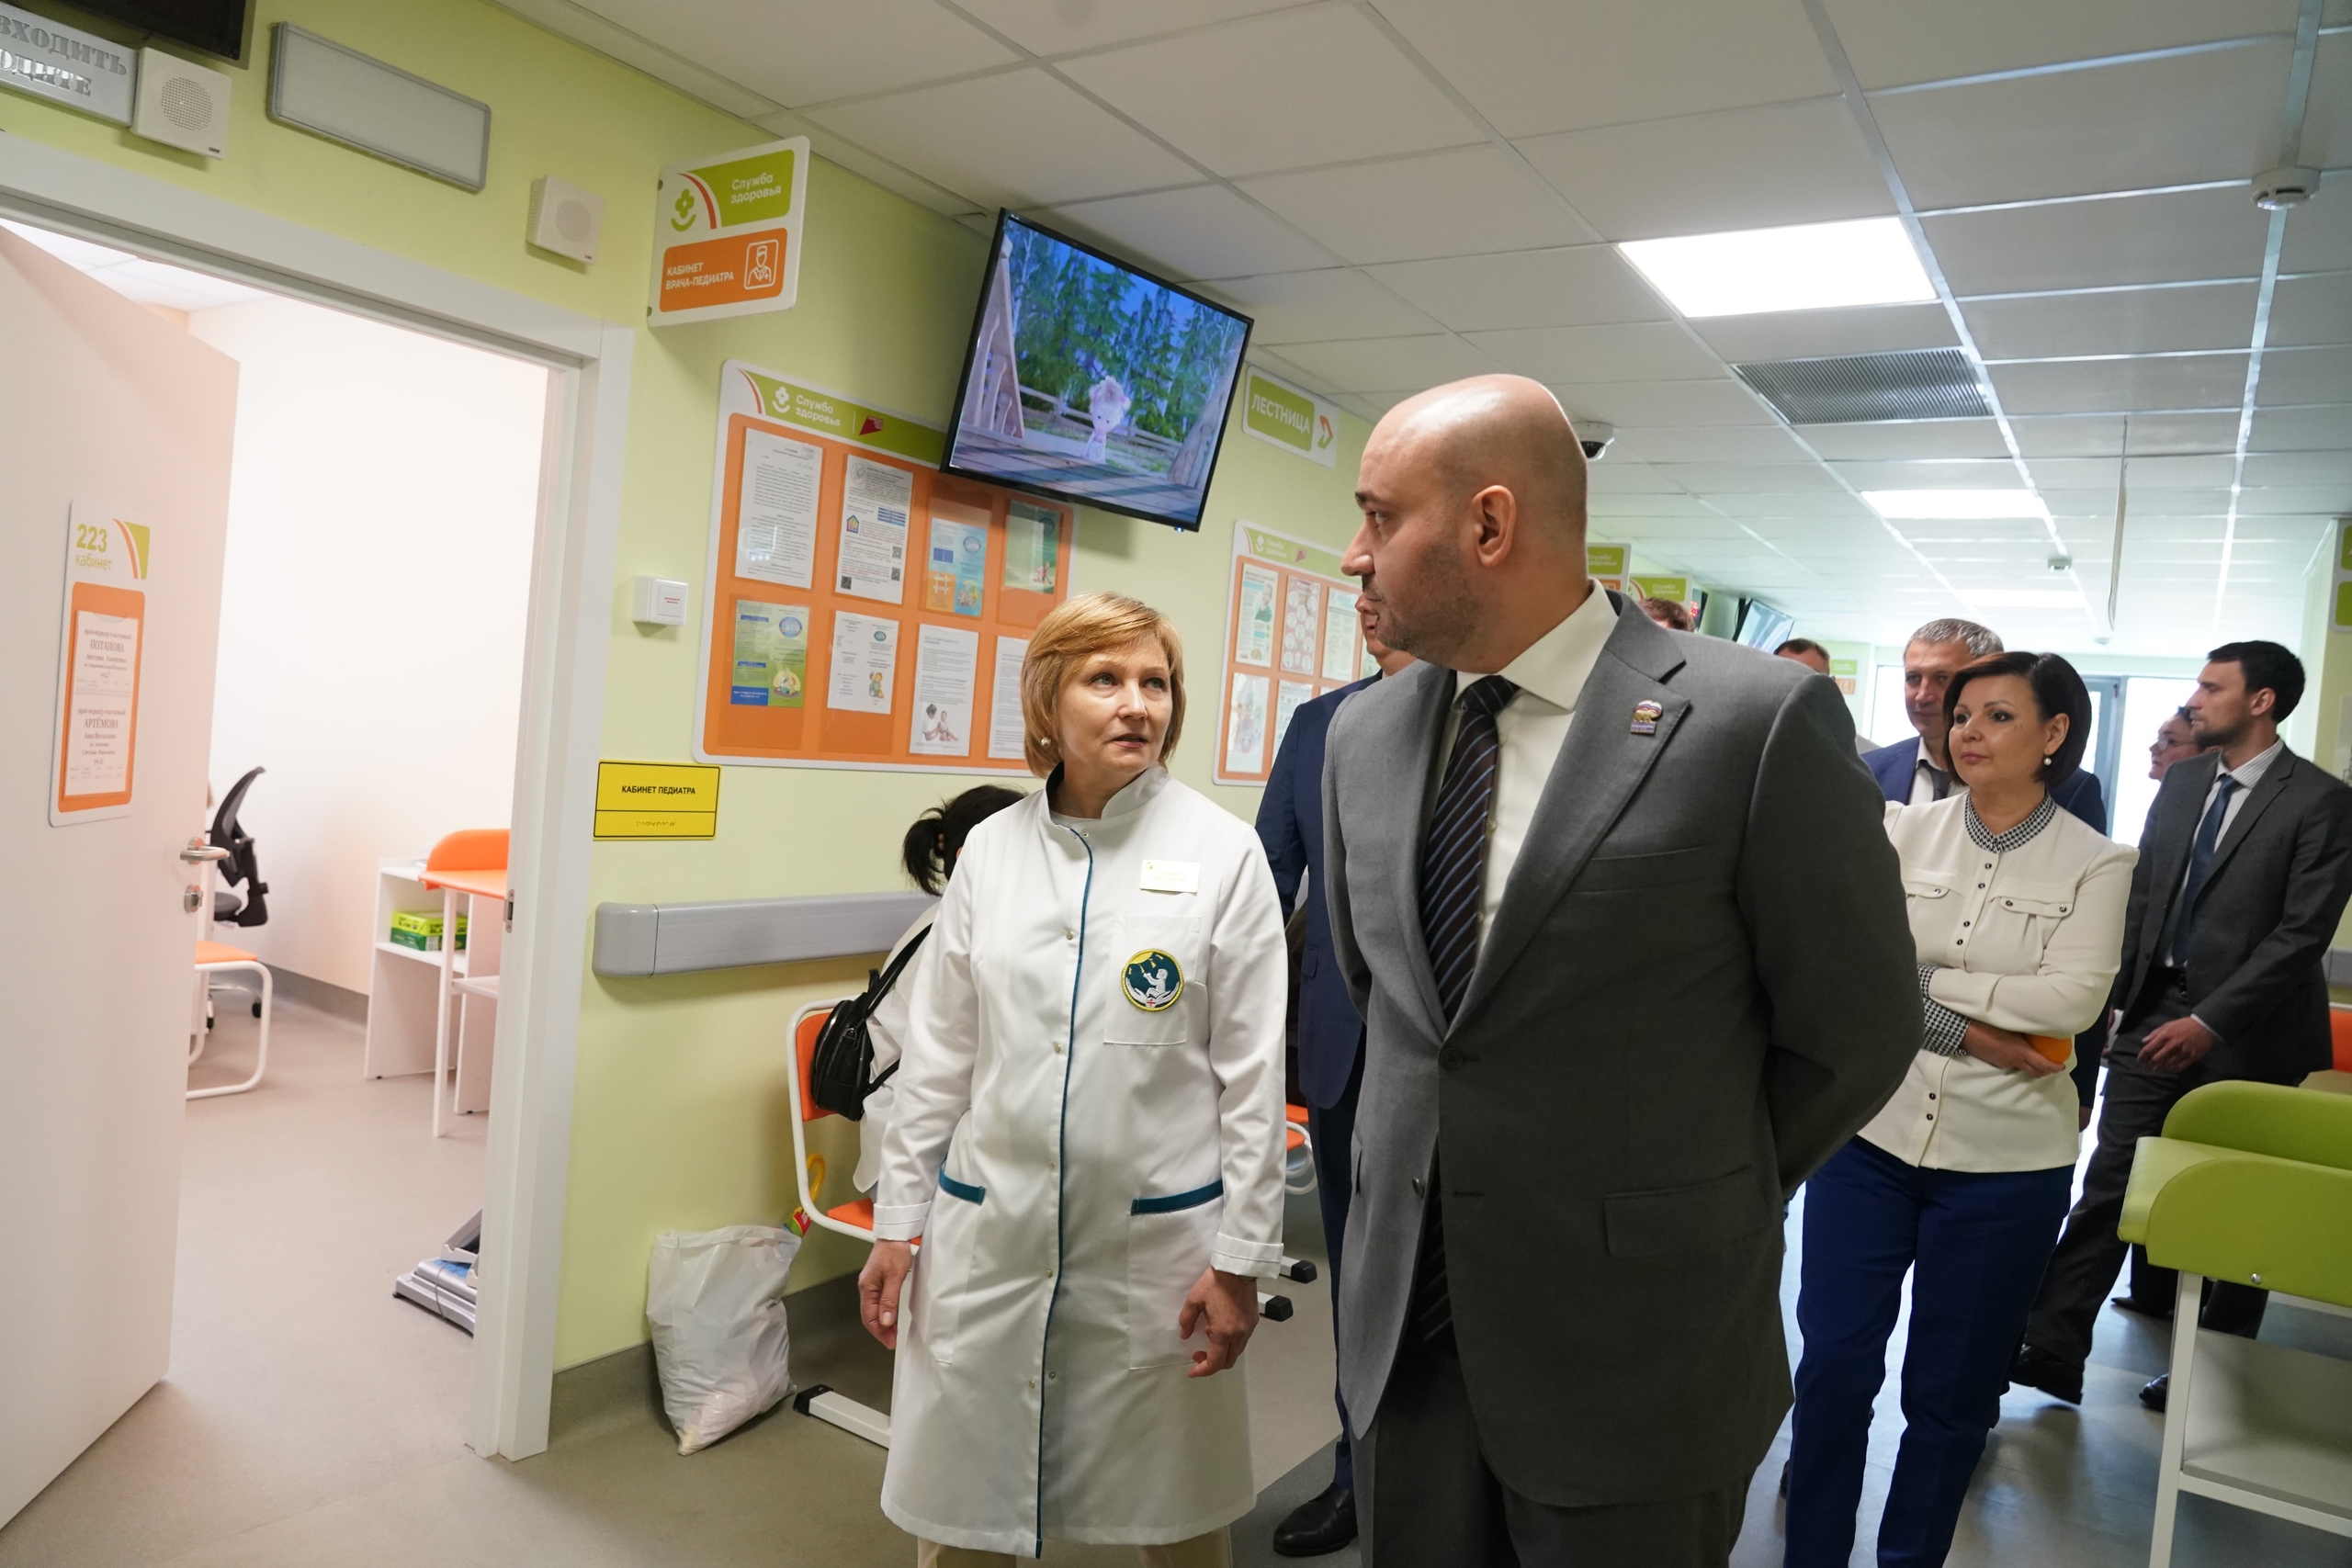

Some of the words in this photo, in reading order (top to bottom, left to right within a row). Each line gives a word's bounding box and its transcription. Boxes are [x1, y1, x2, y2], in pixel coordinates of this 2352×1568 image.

[732, 173, 774, 190] Служба
[730, 186, 781, 204] здоровья
[667, 262, 704, 276] КАБИНЕТ
[665, 271, 734, 290] ВРАЧА-ПЕДИАТРА
[796, 394, 833, 413] Служба
[795, 407, 841, 427] здоровья
[1251, 393, 1310, 434] ЛЕСТНИЦА
[76, 524, 107, 553] 223
[75, 553, 112, 570] кабинет
[90, 639, 125, 653] ПОТАПОВА
[84, 716, 119, 728] АРТЁМОВА
[622, 785, 657, 794] КАБИНЕТ
[658, 786, 696, 795] ПЕДИАТРА
